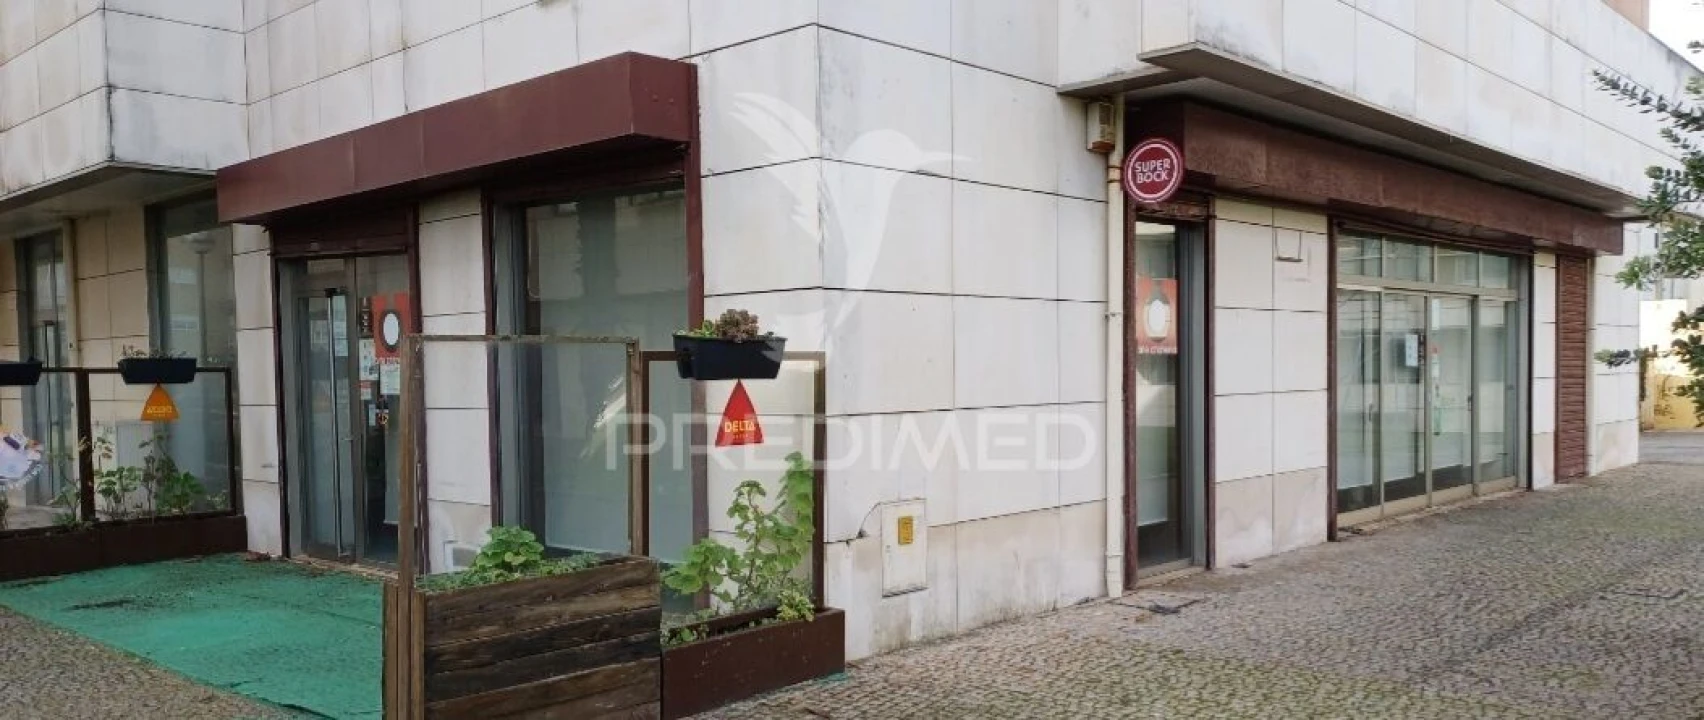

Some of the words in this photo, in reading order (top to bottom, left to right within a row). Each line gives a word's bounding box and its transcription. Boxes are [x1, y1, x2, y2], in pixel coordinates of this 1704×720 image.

[1135, 158, 1171, 172] SUPER
[1136, 170, 1170, 183] BOCK
[724, 420, 756, 433] DELTA
